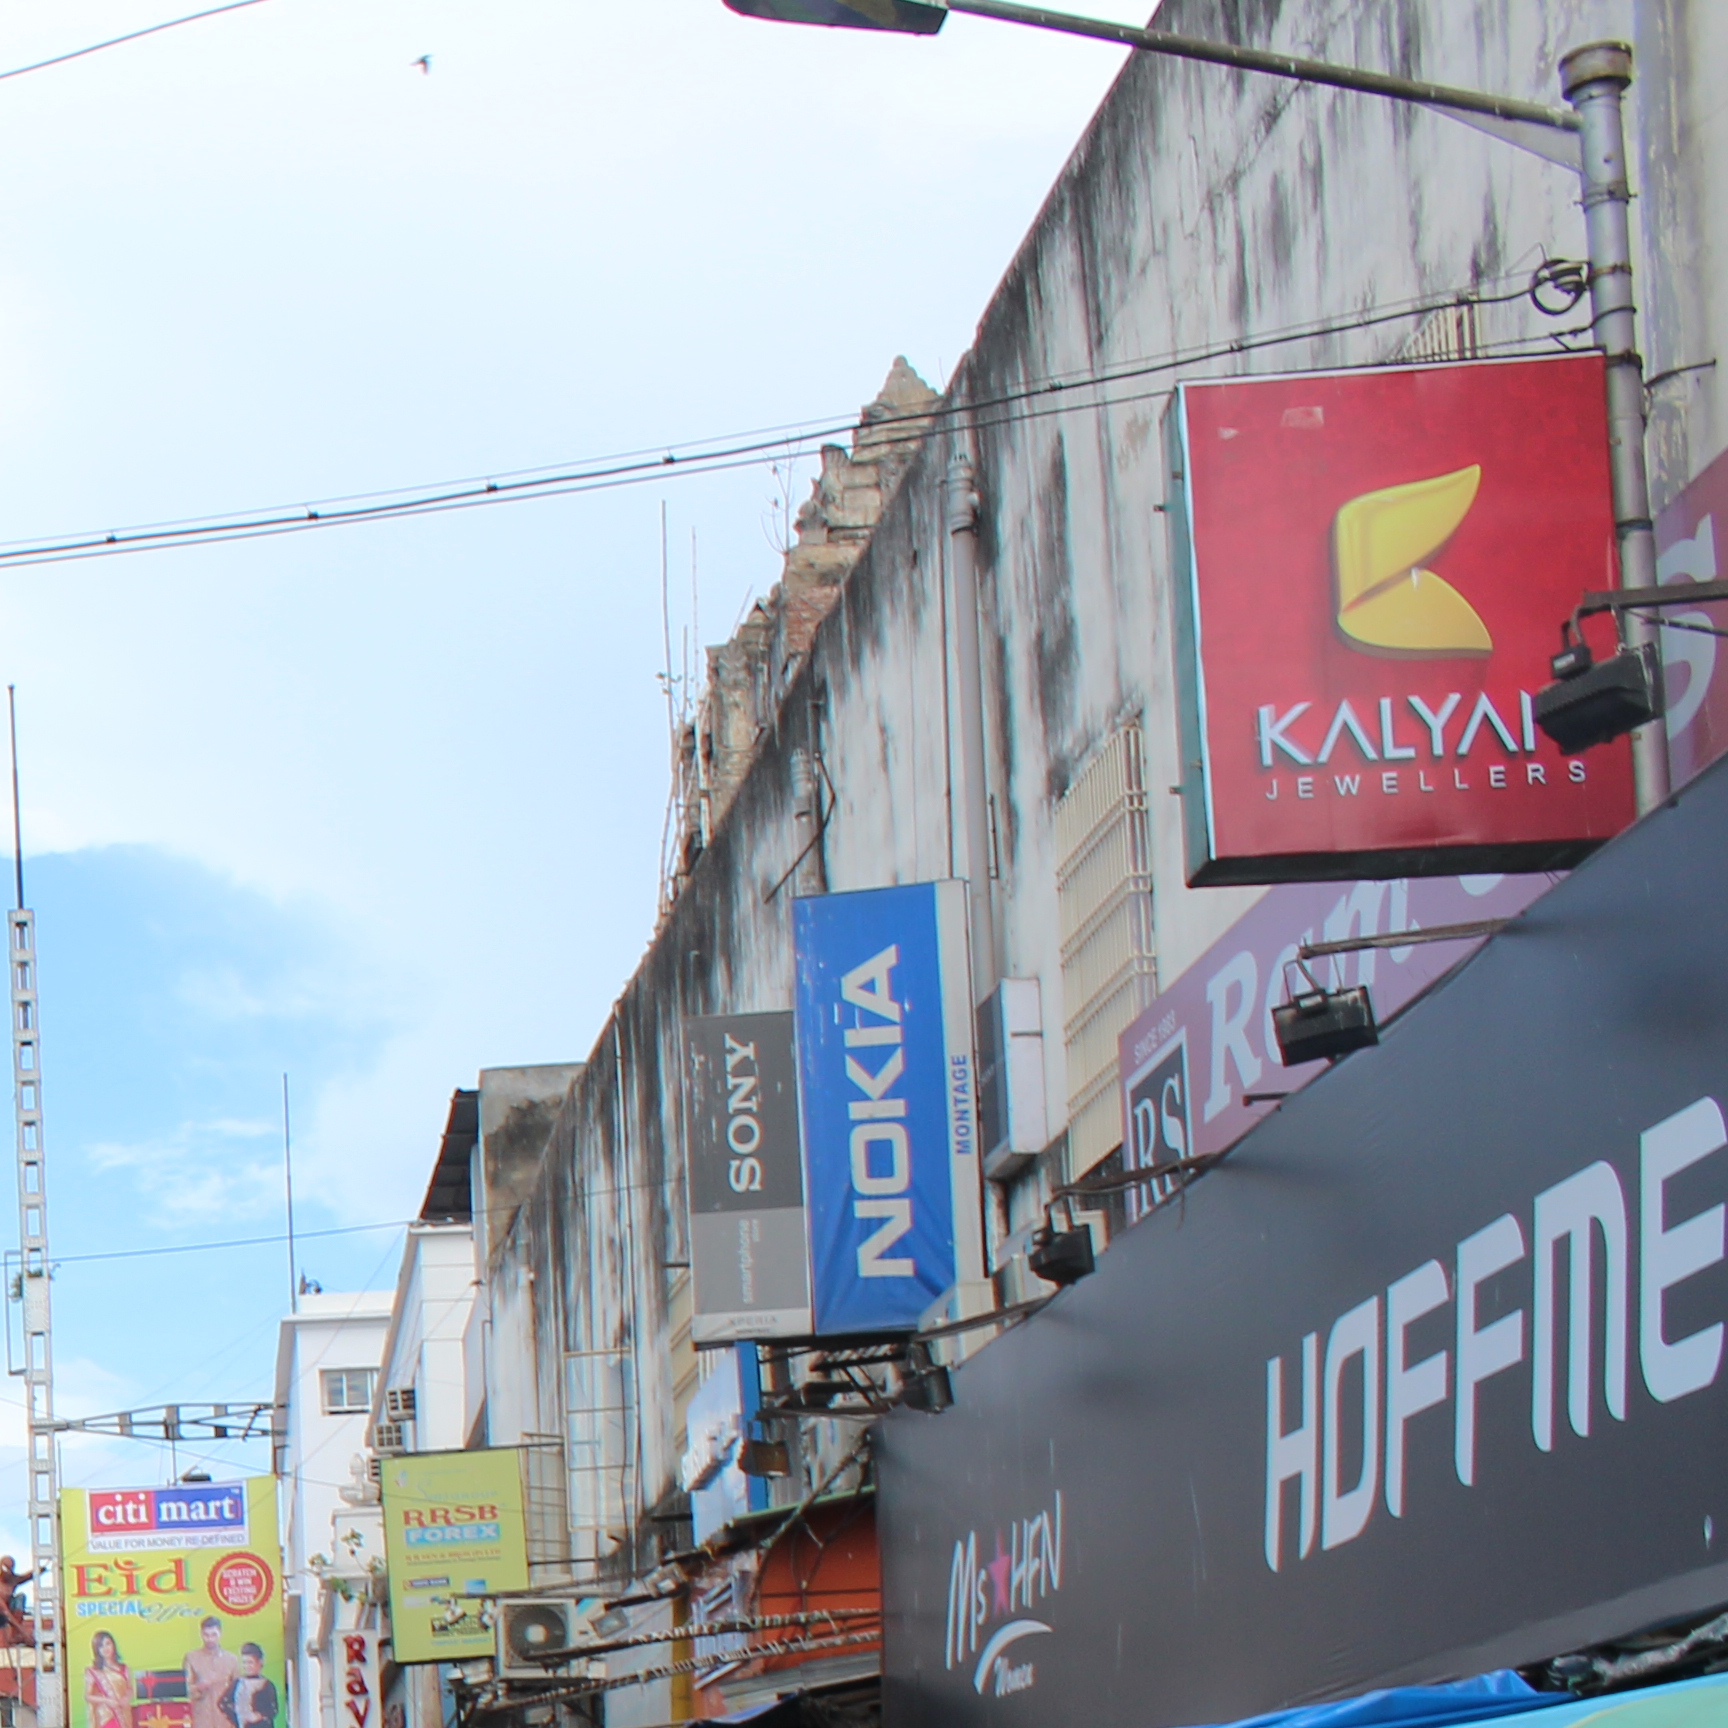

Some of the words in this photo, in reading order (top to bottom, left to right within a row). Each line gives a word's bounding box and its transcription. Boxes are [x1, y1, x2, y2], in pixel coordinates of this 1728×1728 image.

[1259, 689, 1535, 767] KALYA
[1266, 761, 1586, 800] JEWELLERS
[723, 1032, 765, 1194] SONY
[841, 944, 916, 1278] NOKIA
[950, 1054, 971, 1155] MONTAGE
[97, 1493, 150, 1526] citi
[158, 1497, 236, 1523] mart
[402, 1504, 499, 1528] RRSB
[90, 1537, 123, 1550] VALUE
[124, 1537, 146, 1549] FOR
[148, 1535, 184, 1548] MONEY
[408, 1526, 498, 1544] FOREX
[70, 1557, 191, 1598] Eid
[76, 1600, 143, 1617] SPECIAL
